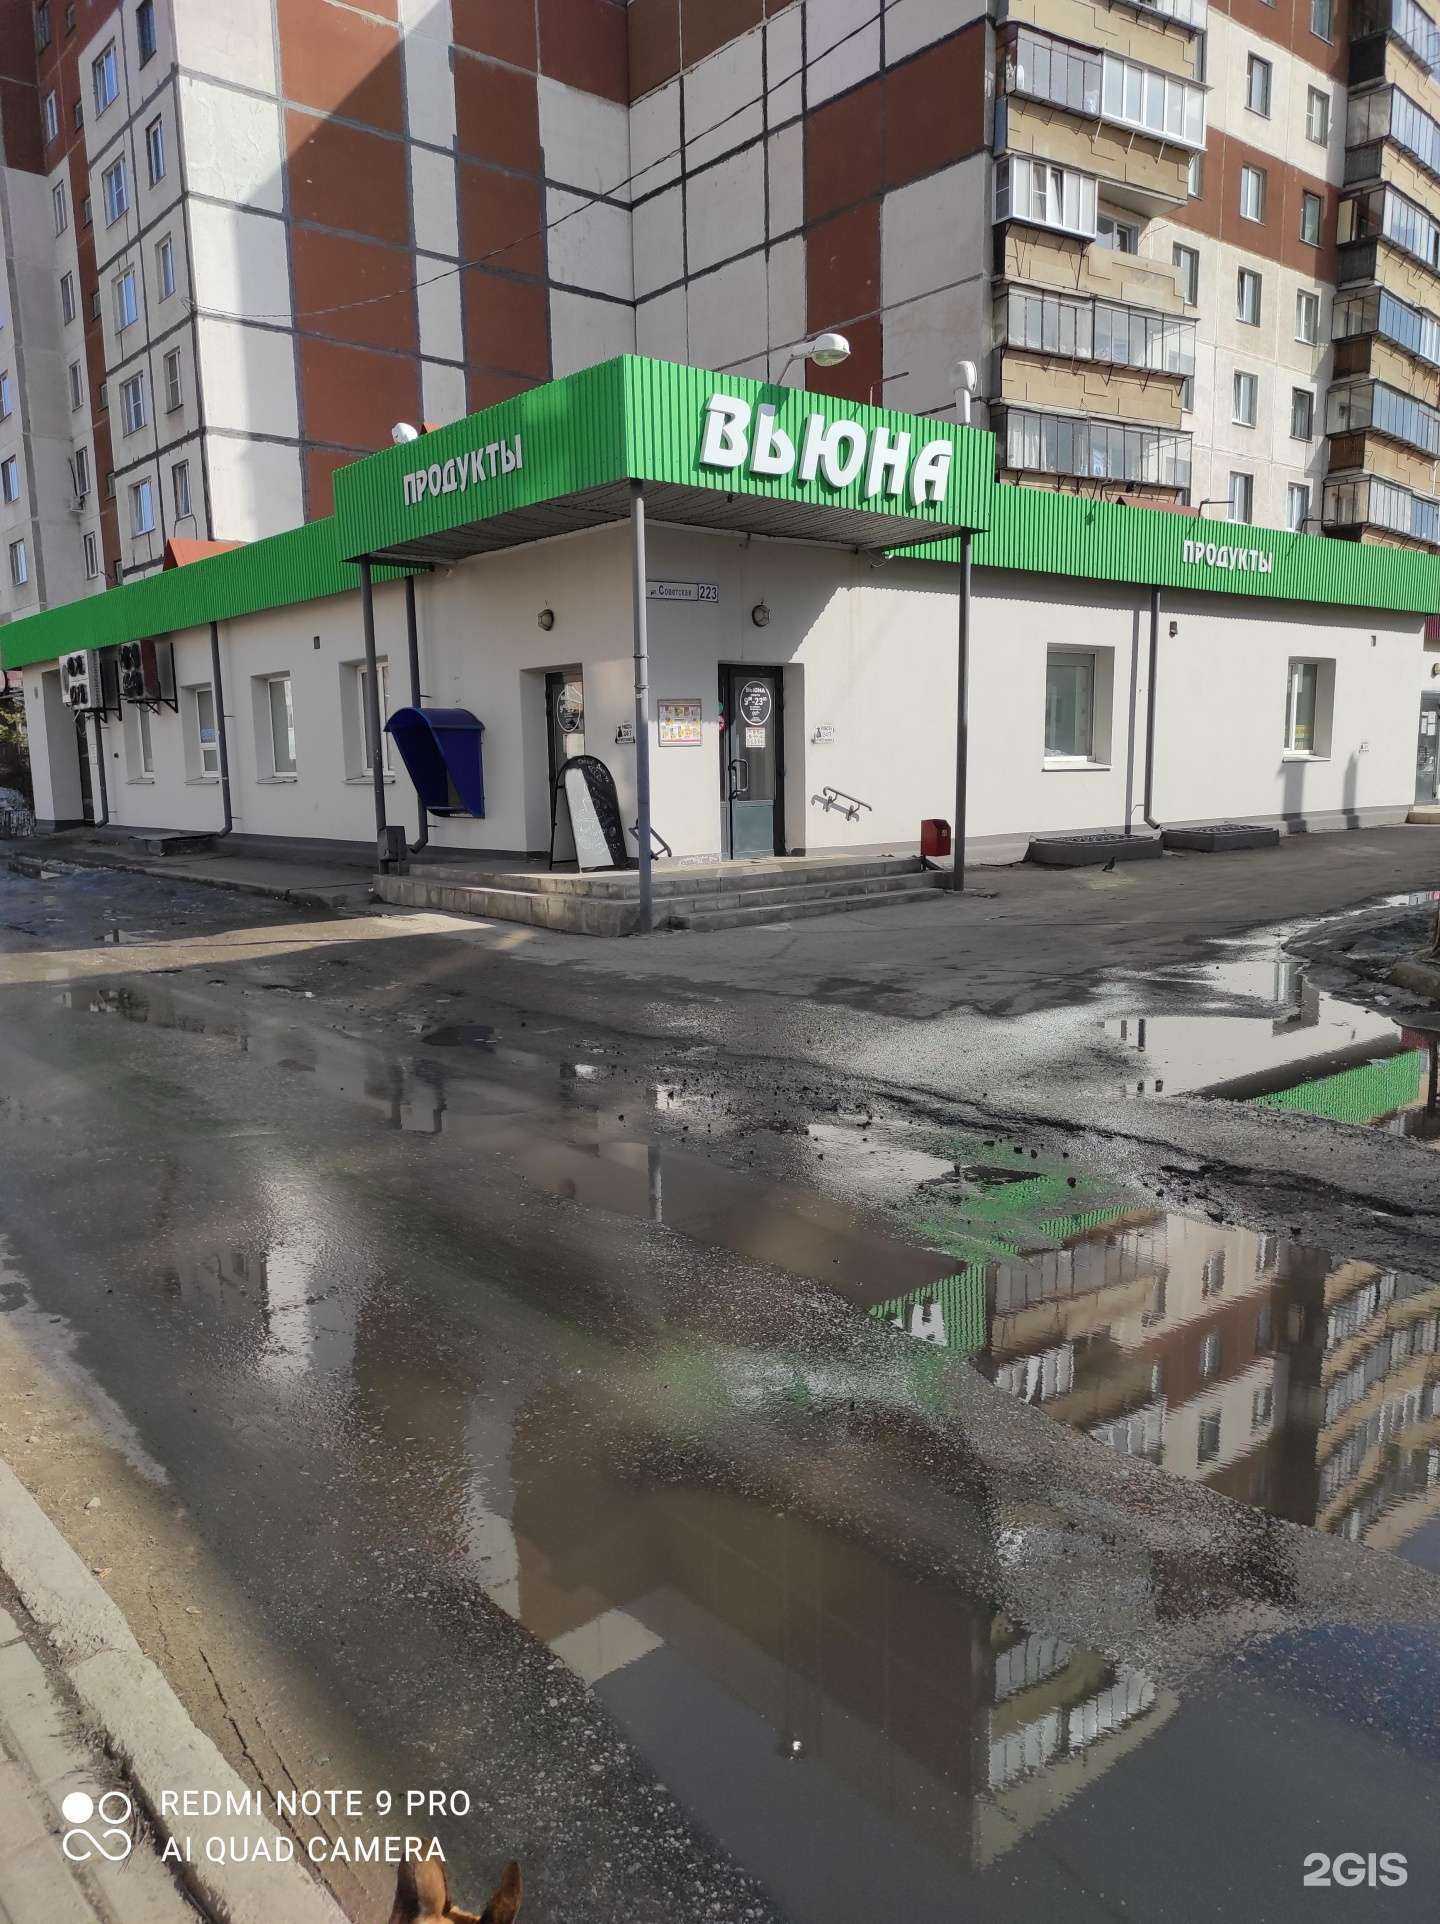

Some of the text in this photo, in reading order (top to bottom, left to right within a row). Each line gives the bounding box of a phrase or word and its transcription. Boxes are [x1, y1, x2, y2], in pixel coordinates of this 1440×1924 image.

[403, 435, 523, 505] ПРОДУКТЫ
[700, 393, 952, 505] ВЬЮНА
[1182, 540, 1273, 574] ПРОДУКТЫ
[700, 585, 717, 600] 223
